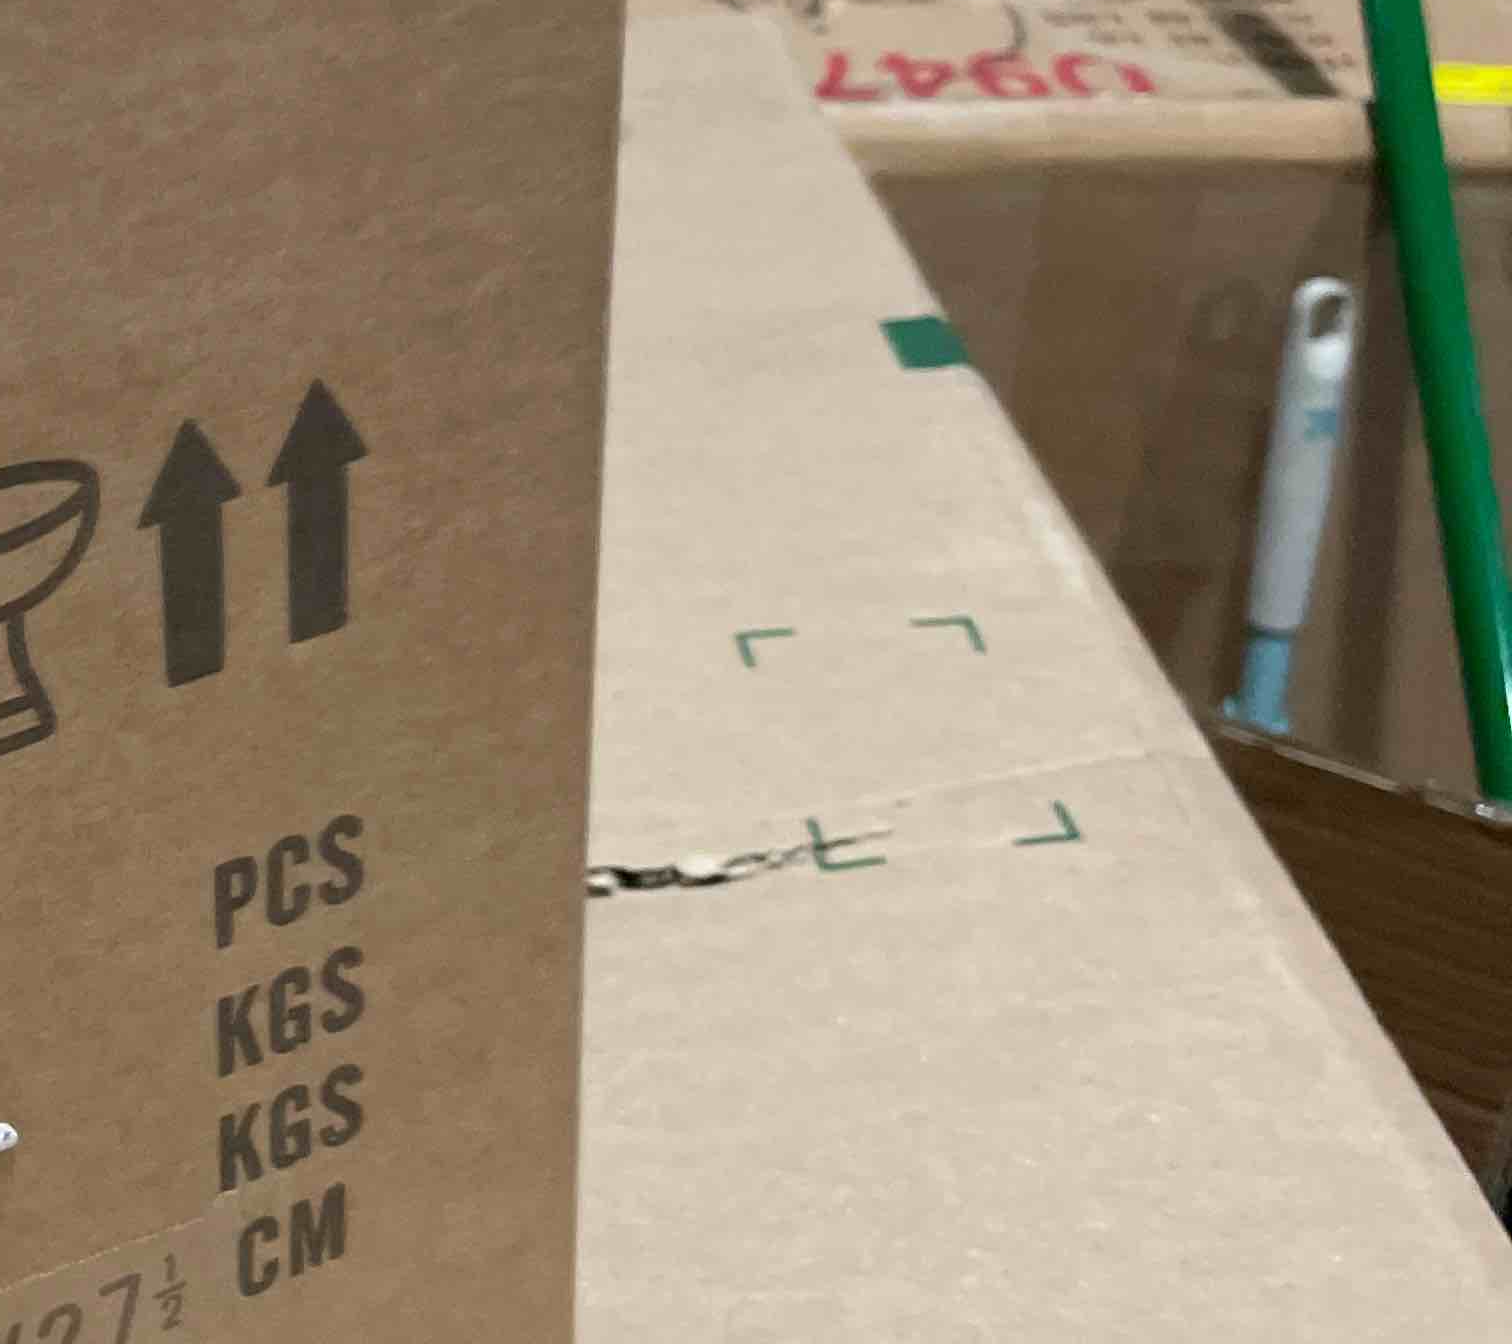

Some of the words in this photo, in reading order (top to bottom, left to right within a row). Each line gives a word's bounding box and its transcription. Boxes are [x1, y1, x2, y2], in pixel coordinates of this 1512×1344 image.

[213, 815, 365, 948] PCS
[215, 946, 366, 1077] KGS
[217, 1064, 364, 1191] KGS
[237, 1182, 348, 1297] CM
